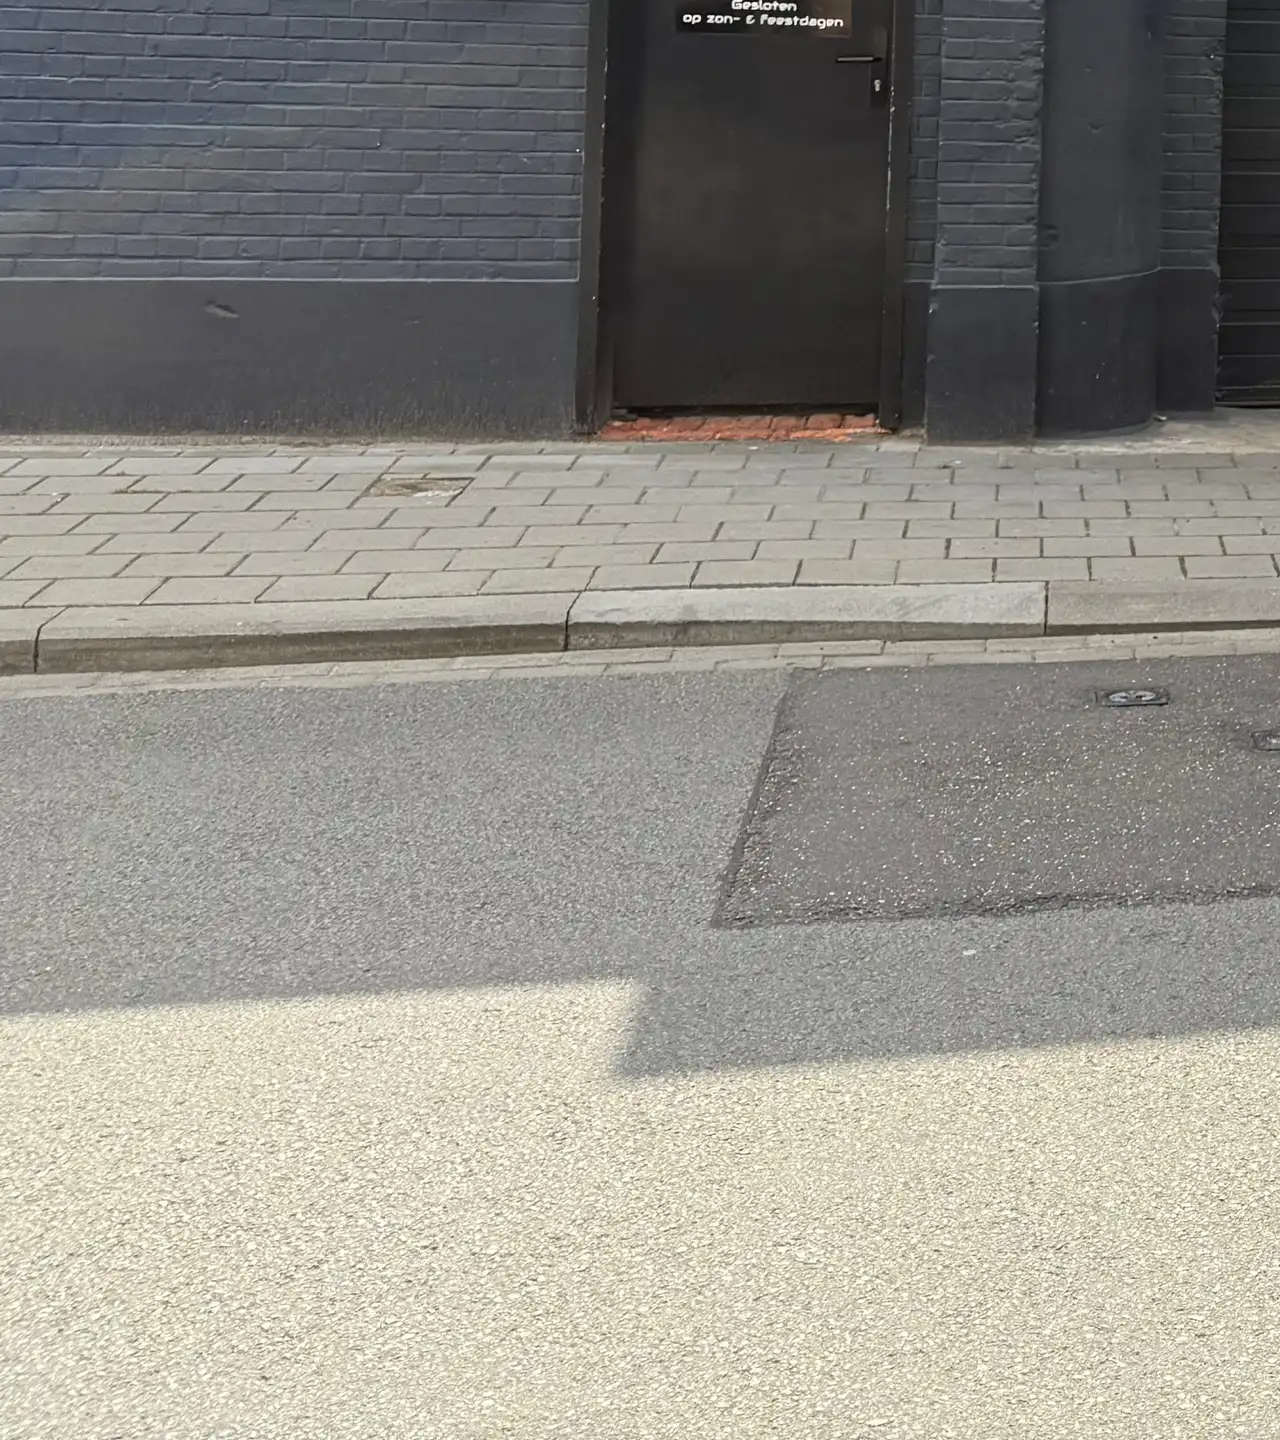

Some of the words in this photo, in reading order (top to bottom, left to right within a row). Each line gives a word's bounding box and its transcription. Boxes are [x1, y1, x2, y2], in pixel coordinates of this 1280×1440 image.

[731, 0, 797, 11] Gesloten
[682, 14, 702, 25] op
[706, 14, 741, 24] zon-
[760, 14, 844, 29] feestdagen
